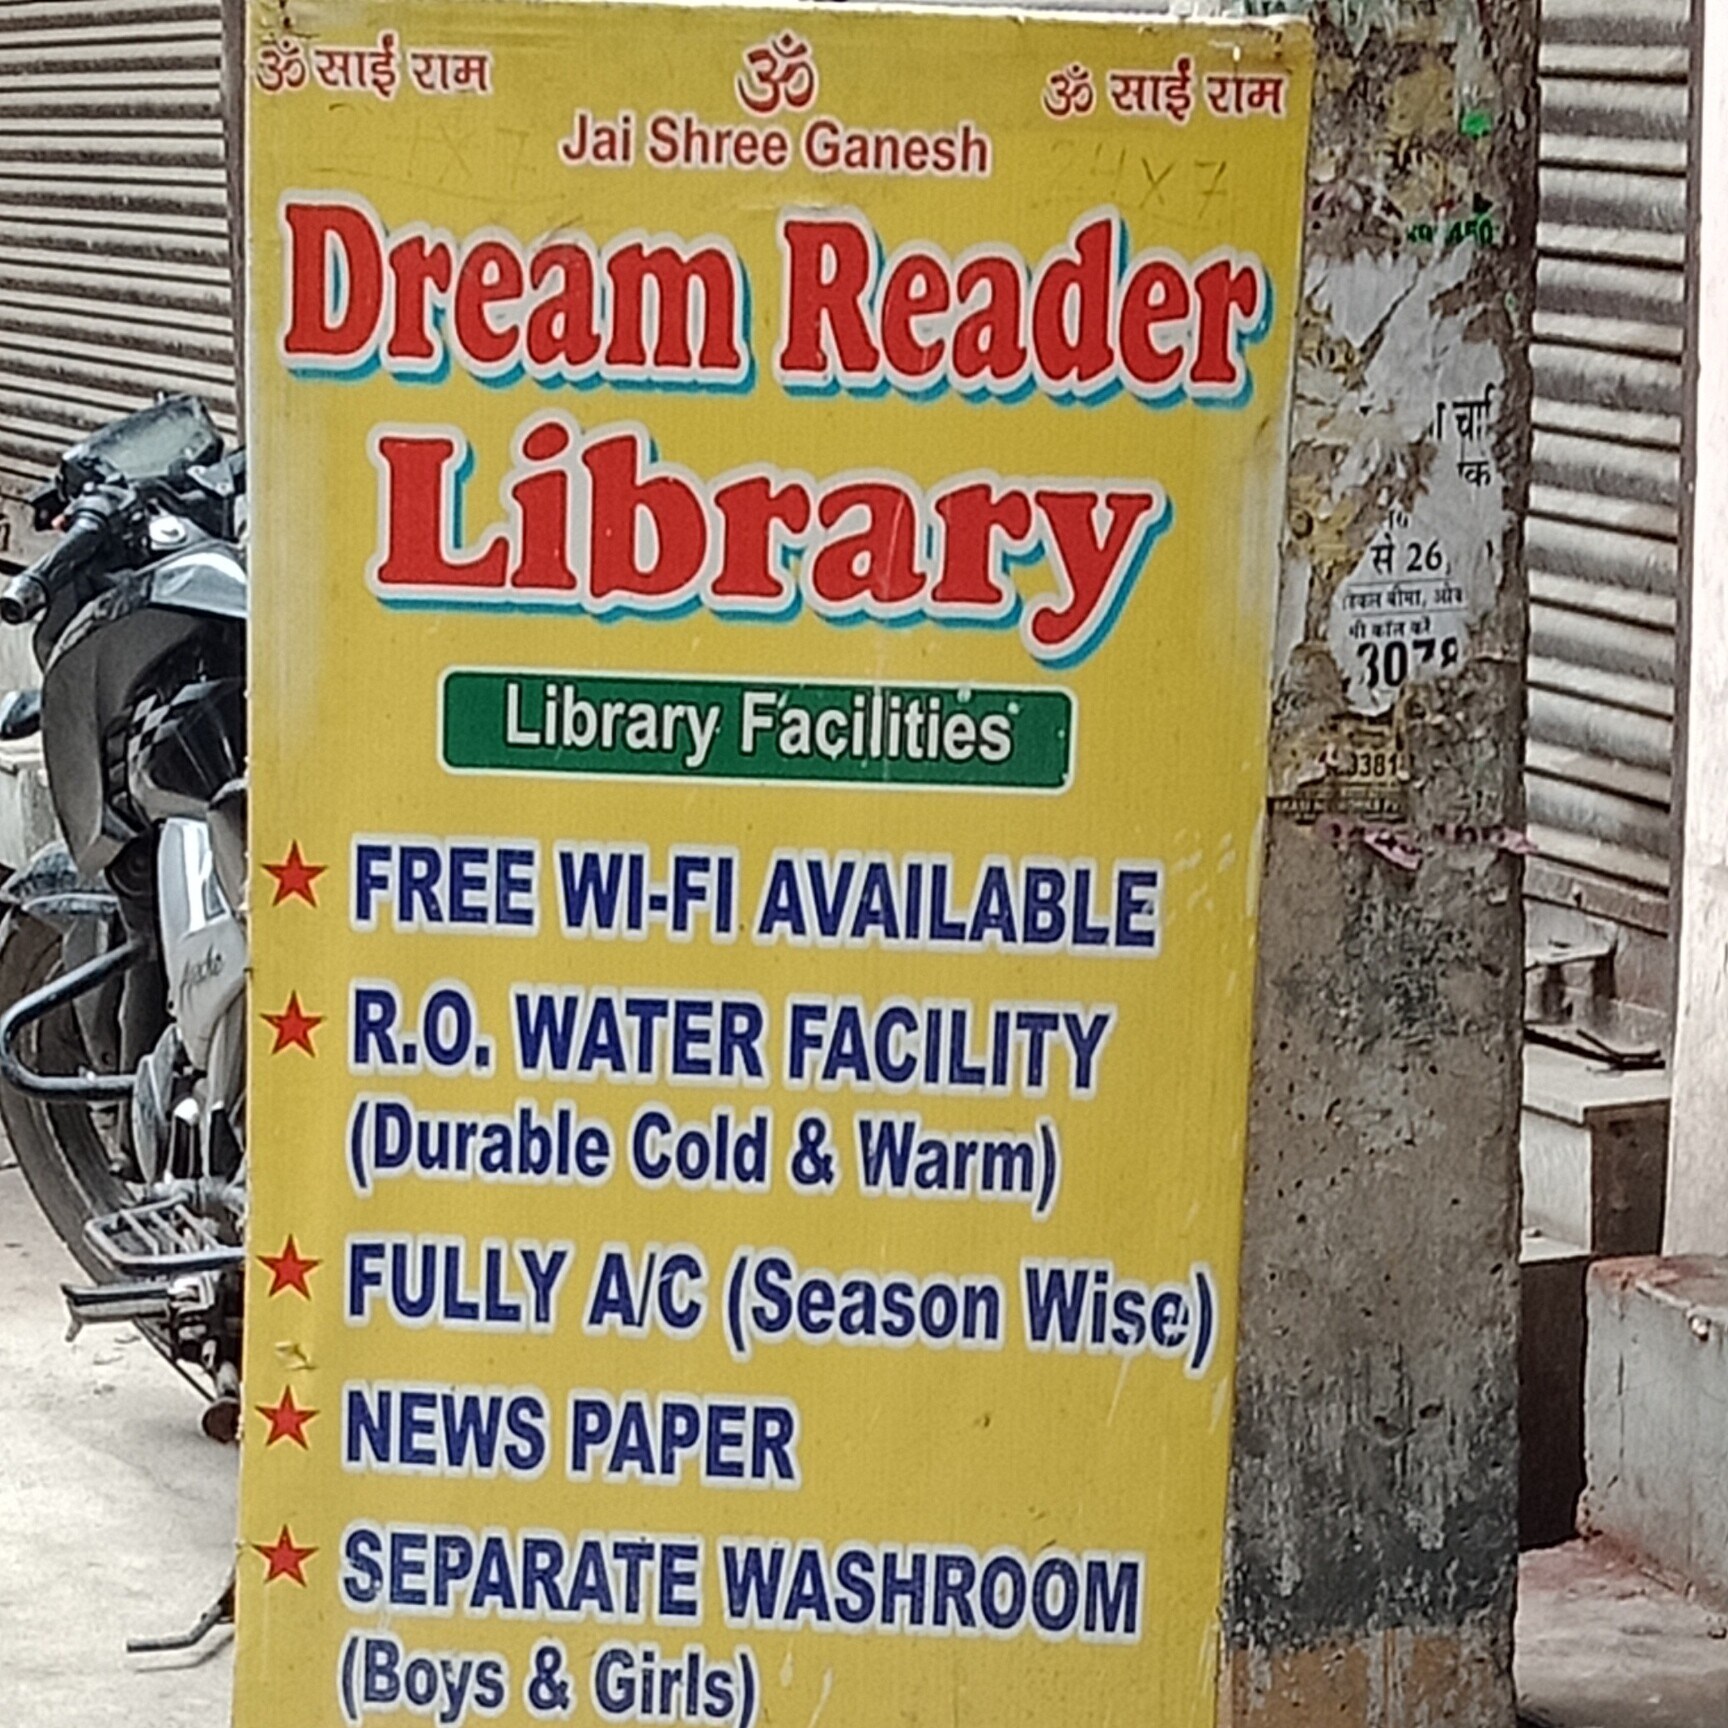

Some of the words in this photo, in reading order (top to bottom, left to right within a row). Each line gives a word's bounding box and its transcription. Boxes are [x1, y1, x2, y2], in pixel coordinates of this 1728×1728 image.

[410, 52, 488, 92] राम
[1206, 75, 1285, 115] राम
[561, 113, 632, 163] Jai
[647, 115, 789, 167] Shree
[803, 119, 989, 173] Ganesh
[280, 199, 747, 375] Dream
[776, 215, 1262, 390] Reader
[374, 418, 1157, 650] Library
[505, 681, 722, 769] Library
[740, 687, 1013, 763] Facilities
[354, 842, 536, 928] FREE
[557, 849, 735, 935] WI-FI
[757, 857, 1160, 950] AVAILABLE
[352, 986, 492, 1071] R.O.
[513, 992, 765, 1079] WATER
[787, 1001, 1113, 1091] FACILITY
[349, 1100, 611, 1188] (Durable
[631, 1109, 769, 1185] Cold
[790, 1115, 836, 1187] &
[857, 1117, 1059, 1213] Warm)
[347, 1241, 569, 1325] FULLY
[587, 1250, 704, 1331] A/C
[726, 1255, 1001, 1352] (Season
[1024, 1266, 1215, 1370] Wise)
[345, 1388, 547, 1472] NEWS
[570, 1397, 798, 1482] PAPER
[342, 1527, 701, 1618] SEPARATE
[721, 1544, 1141, 1636] WASHROOM
[340, 1637, 506, 1725] (Boys
[526, 1644, 571, 1712] &
